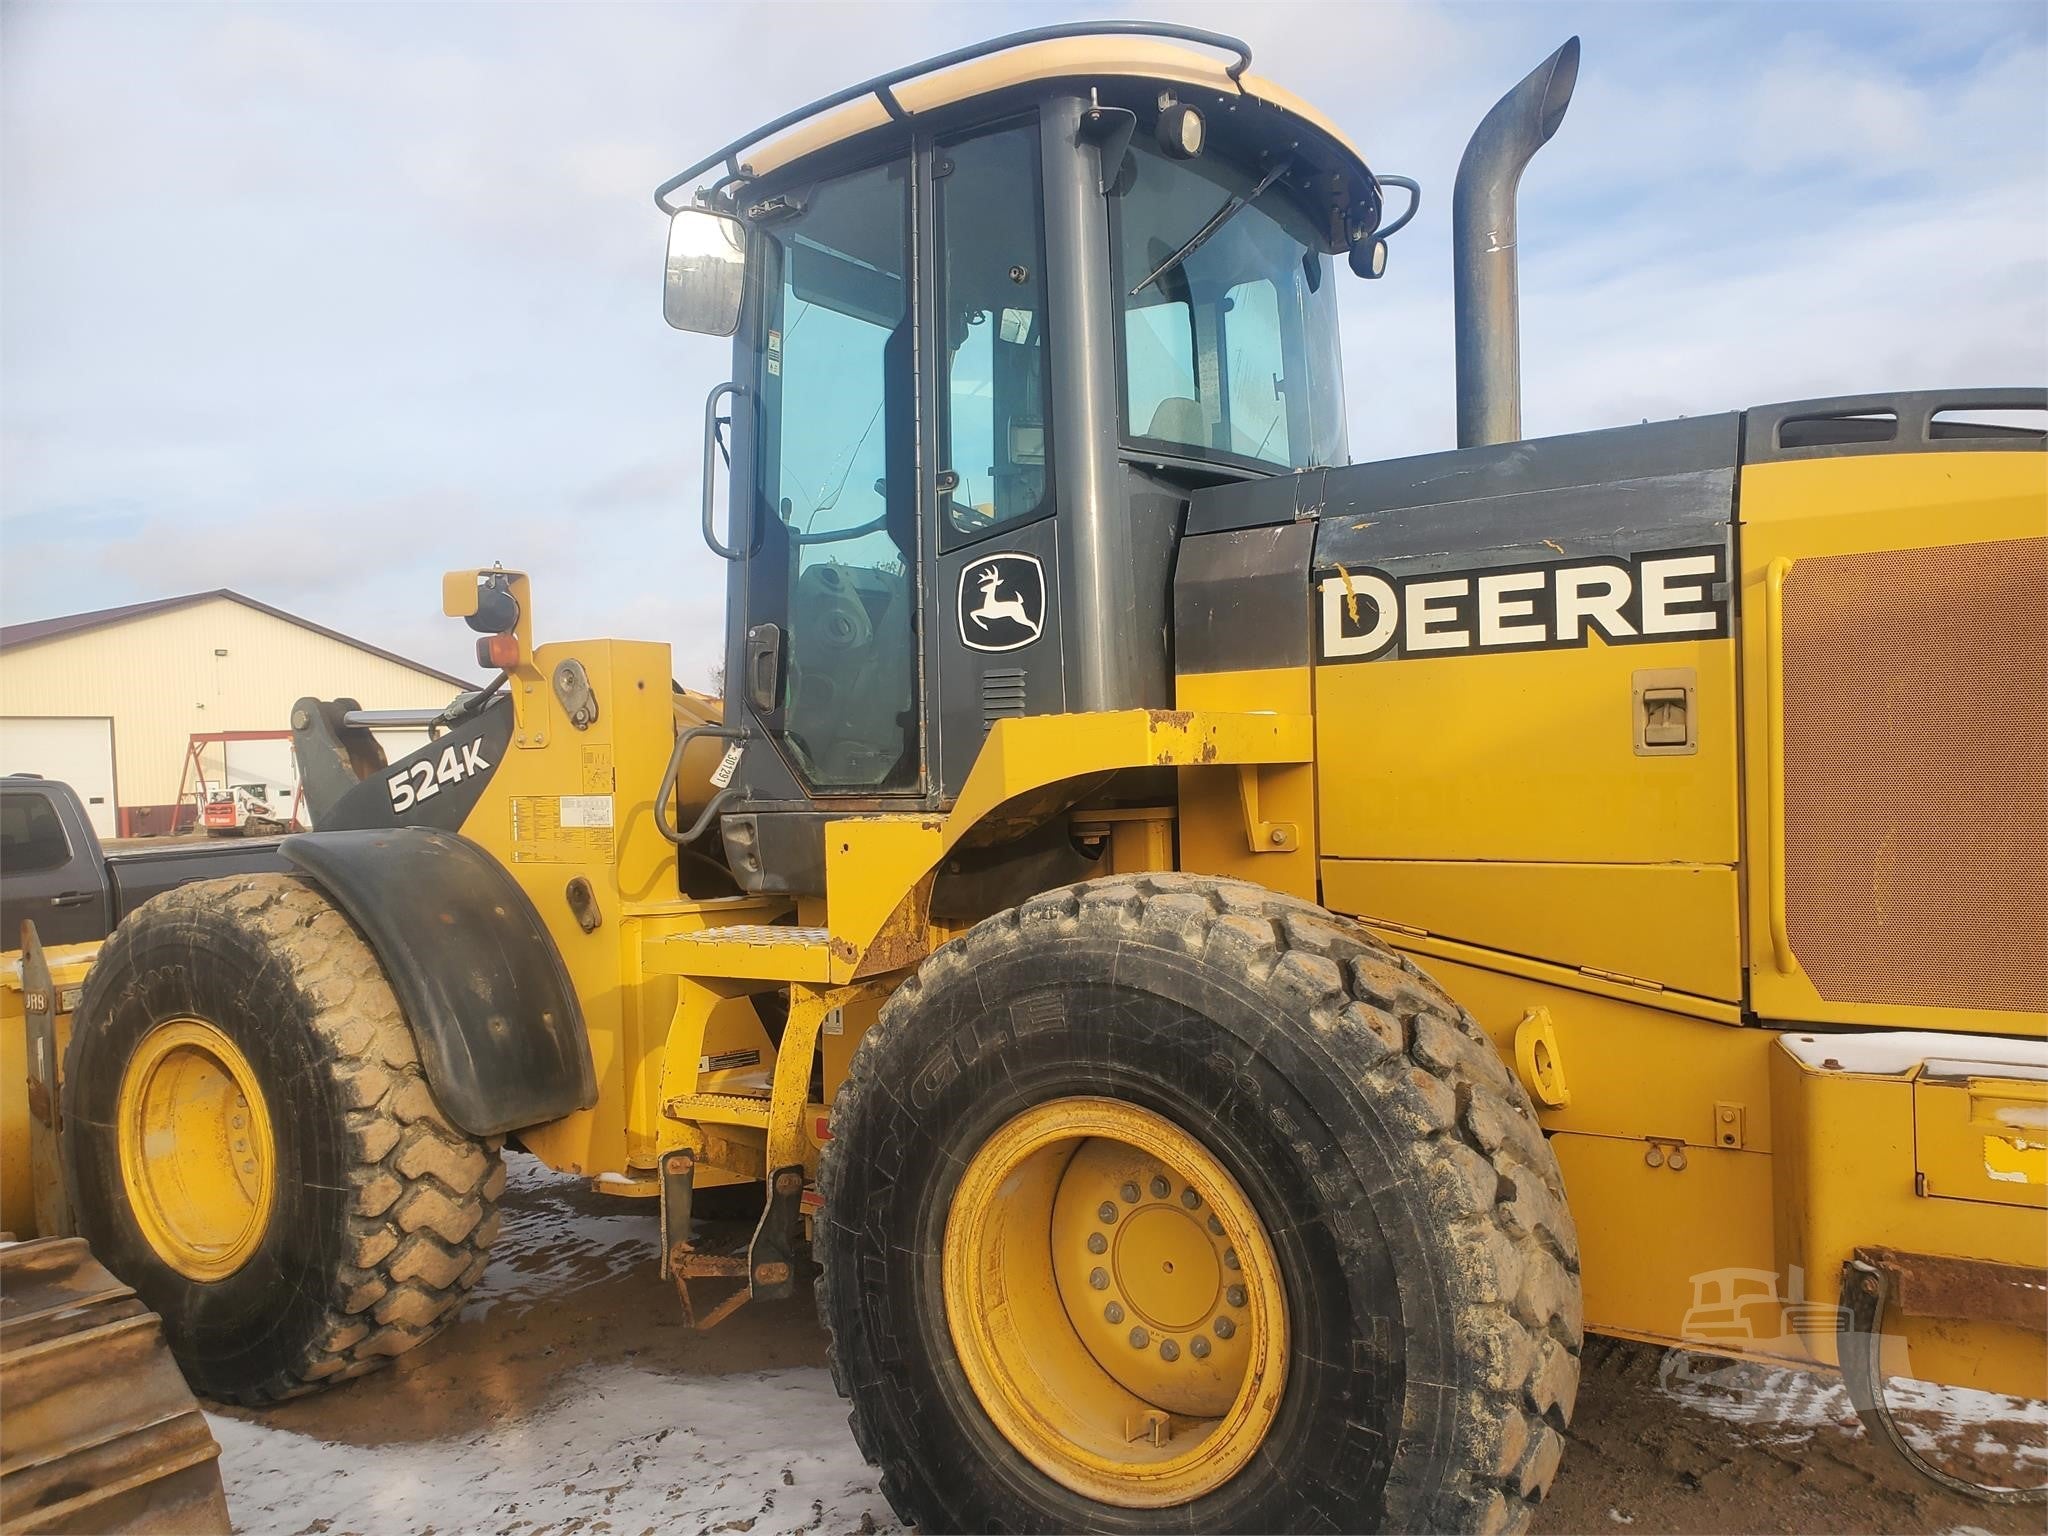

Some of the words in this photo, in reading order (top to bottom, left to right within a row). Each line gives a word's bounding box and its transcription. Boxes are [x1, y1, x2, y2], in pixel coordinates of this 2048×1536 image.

[1322, 554, 1718, 658] DEERE
[387, 737, 491, 813] 524K
[716, 753, 738, 783] 301291
